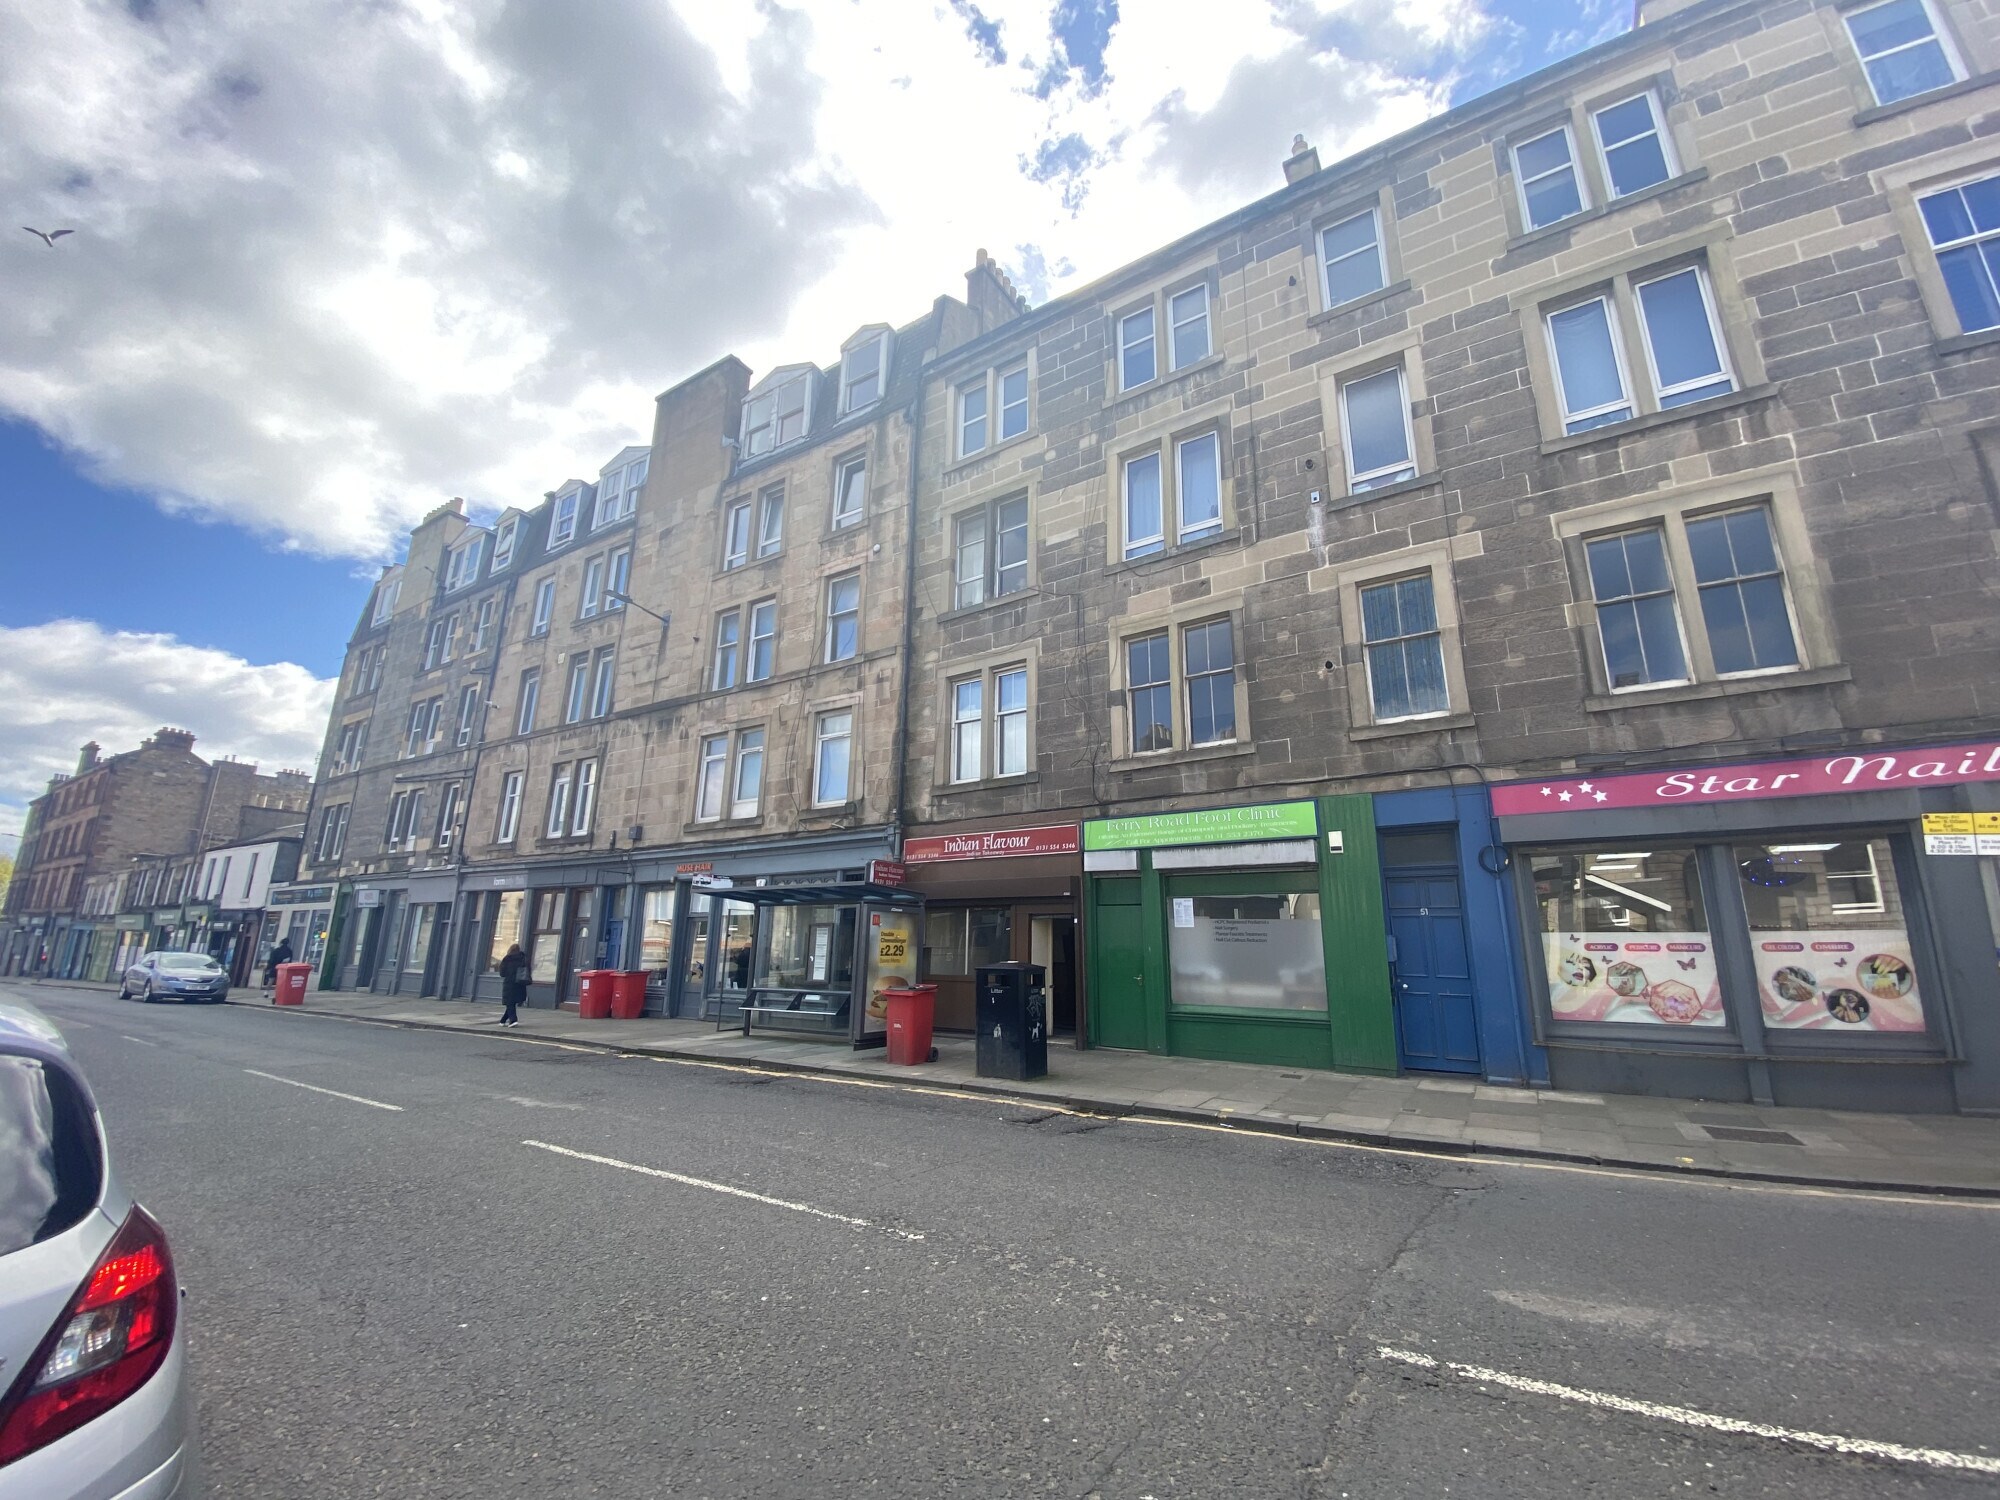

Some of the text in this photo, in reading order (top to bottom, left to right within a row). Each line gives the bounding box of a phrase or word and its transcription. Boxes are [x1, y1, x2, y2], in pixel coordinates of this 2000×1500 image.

[1656, 773, 1800, 797] Star
[1107, 807, 1284, 833] Ferry Road Foot Clinic
[1259, 819, 1299, 828] Treatments
[944, 832, 1031, 854] Indian Flavour
[1153, 831, 1201, 844] Appointments
[1062, 842, 1076, 850] 5346
[1420, 907, 1429, 916] 51
[880, 945, 904, 957] £2.29
